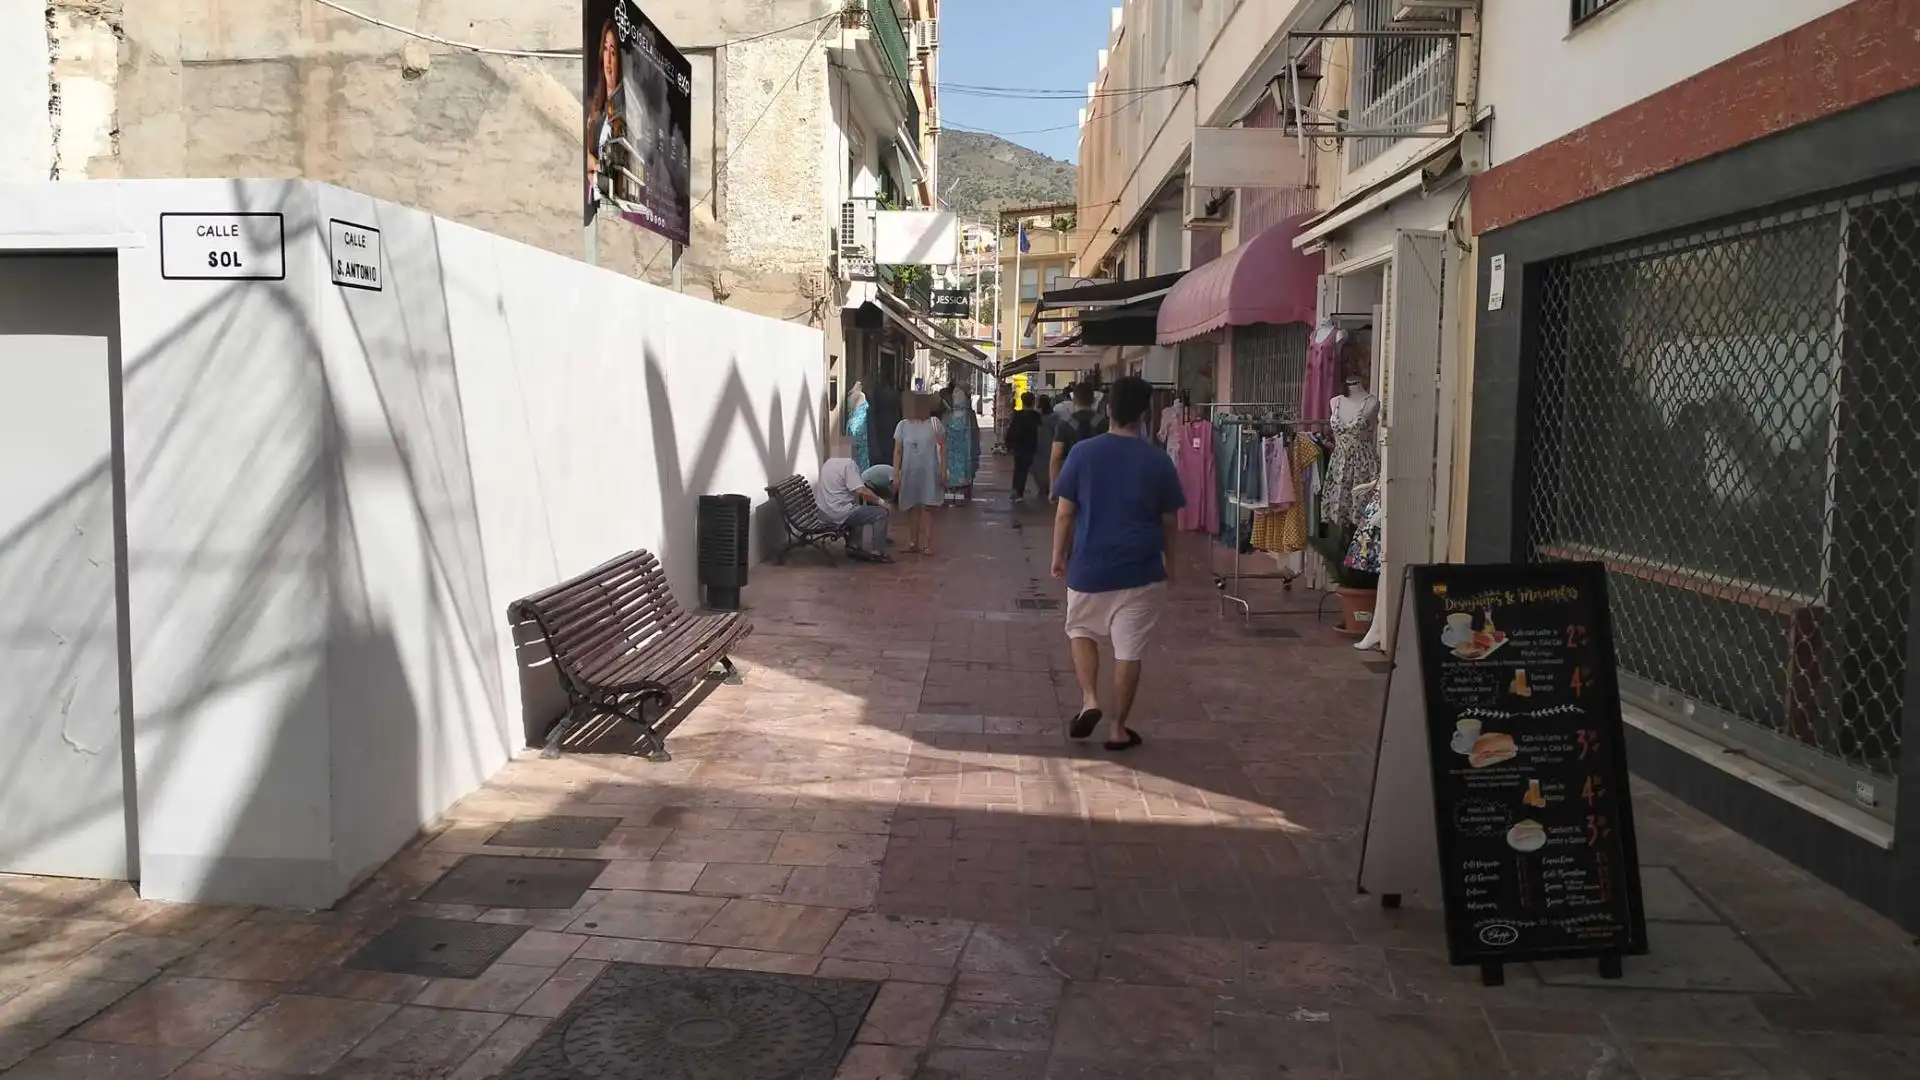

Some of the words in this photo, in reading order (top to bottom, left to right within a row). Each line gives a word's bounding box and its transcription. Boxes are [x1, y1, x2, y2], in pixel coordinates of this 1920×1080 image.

[196, 224, 239, 238] CALLE
[344, 231, 367, 249] CALLE
[207, 251, 242, 268] SOL
[936, 295, 968, 305] JESSICA
